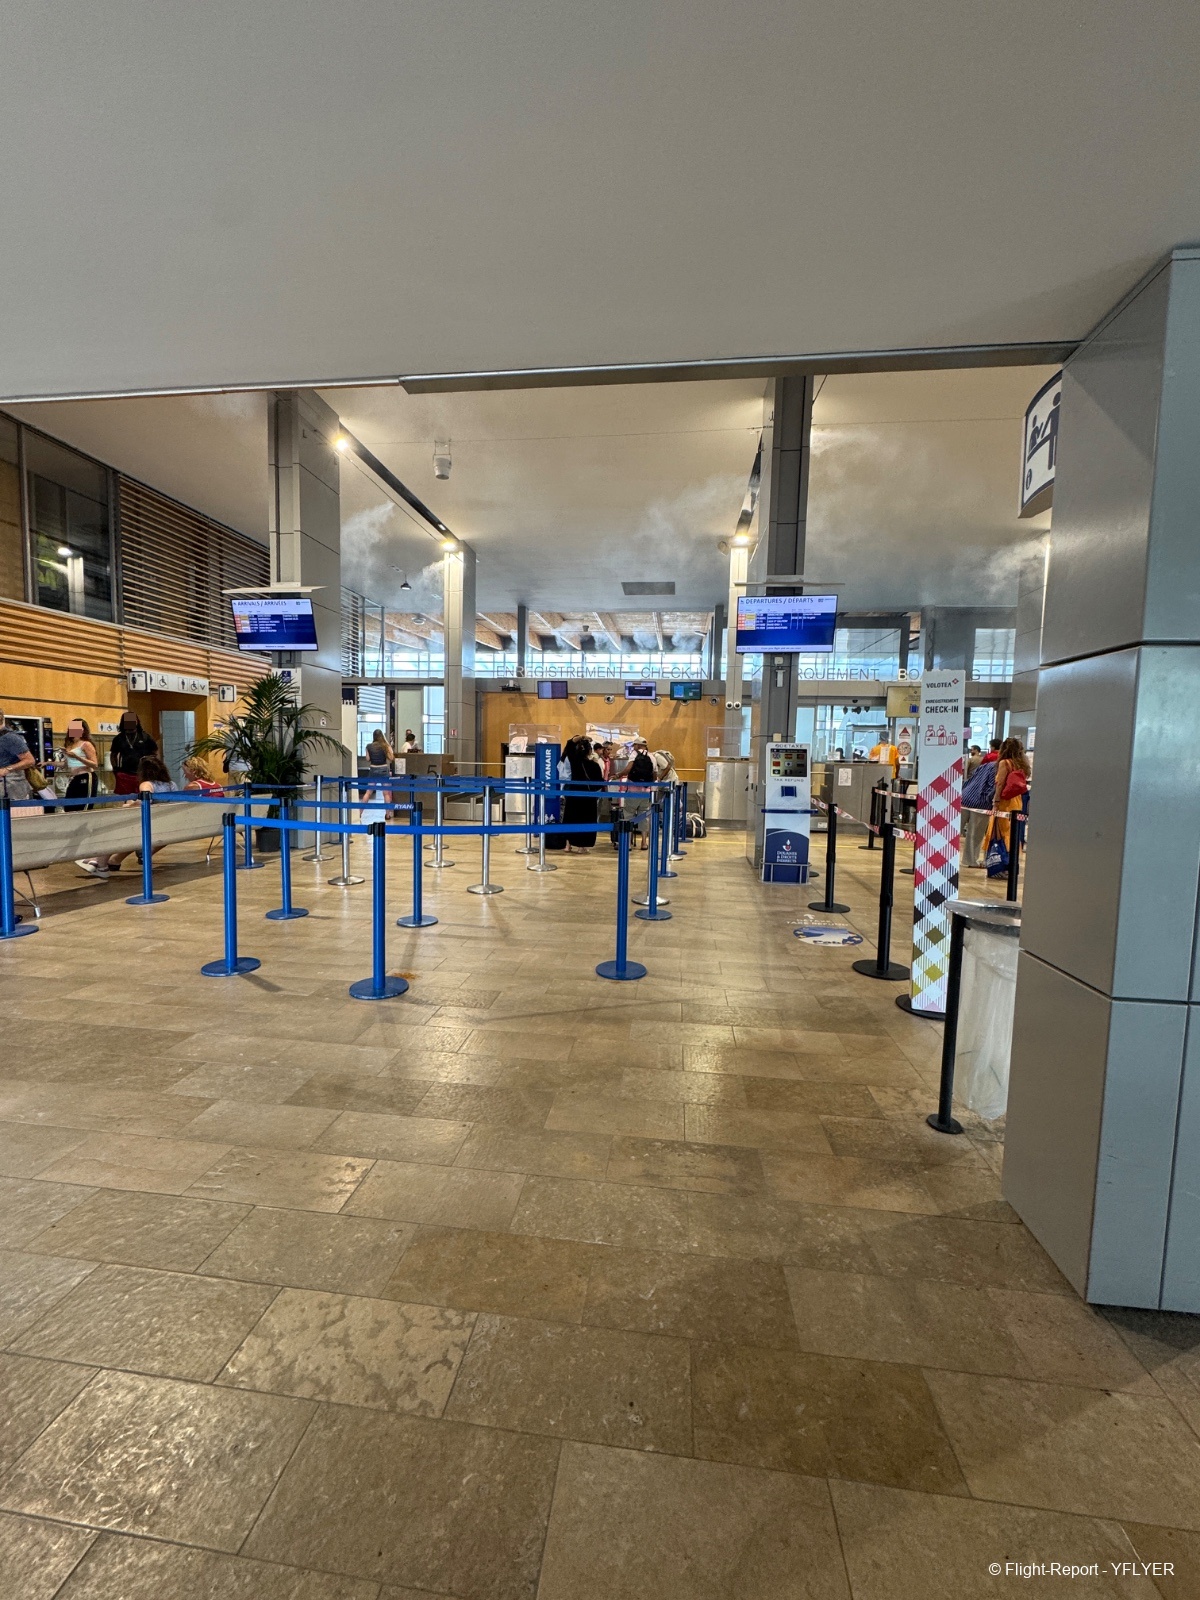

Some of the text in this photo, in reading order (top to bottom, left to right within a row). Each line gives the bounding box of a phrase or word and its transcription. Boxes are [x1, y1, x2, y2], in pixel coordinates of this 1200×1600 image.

[496, 665, 709, 680] ENREGISTREMENT CHECK-IN
[925, 705, 959, 714] CHECK-IN
